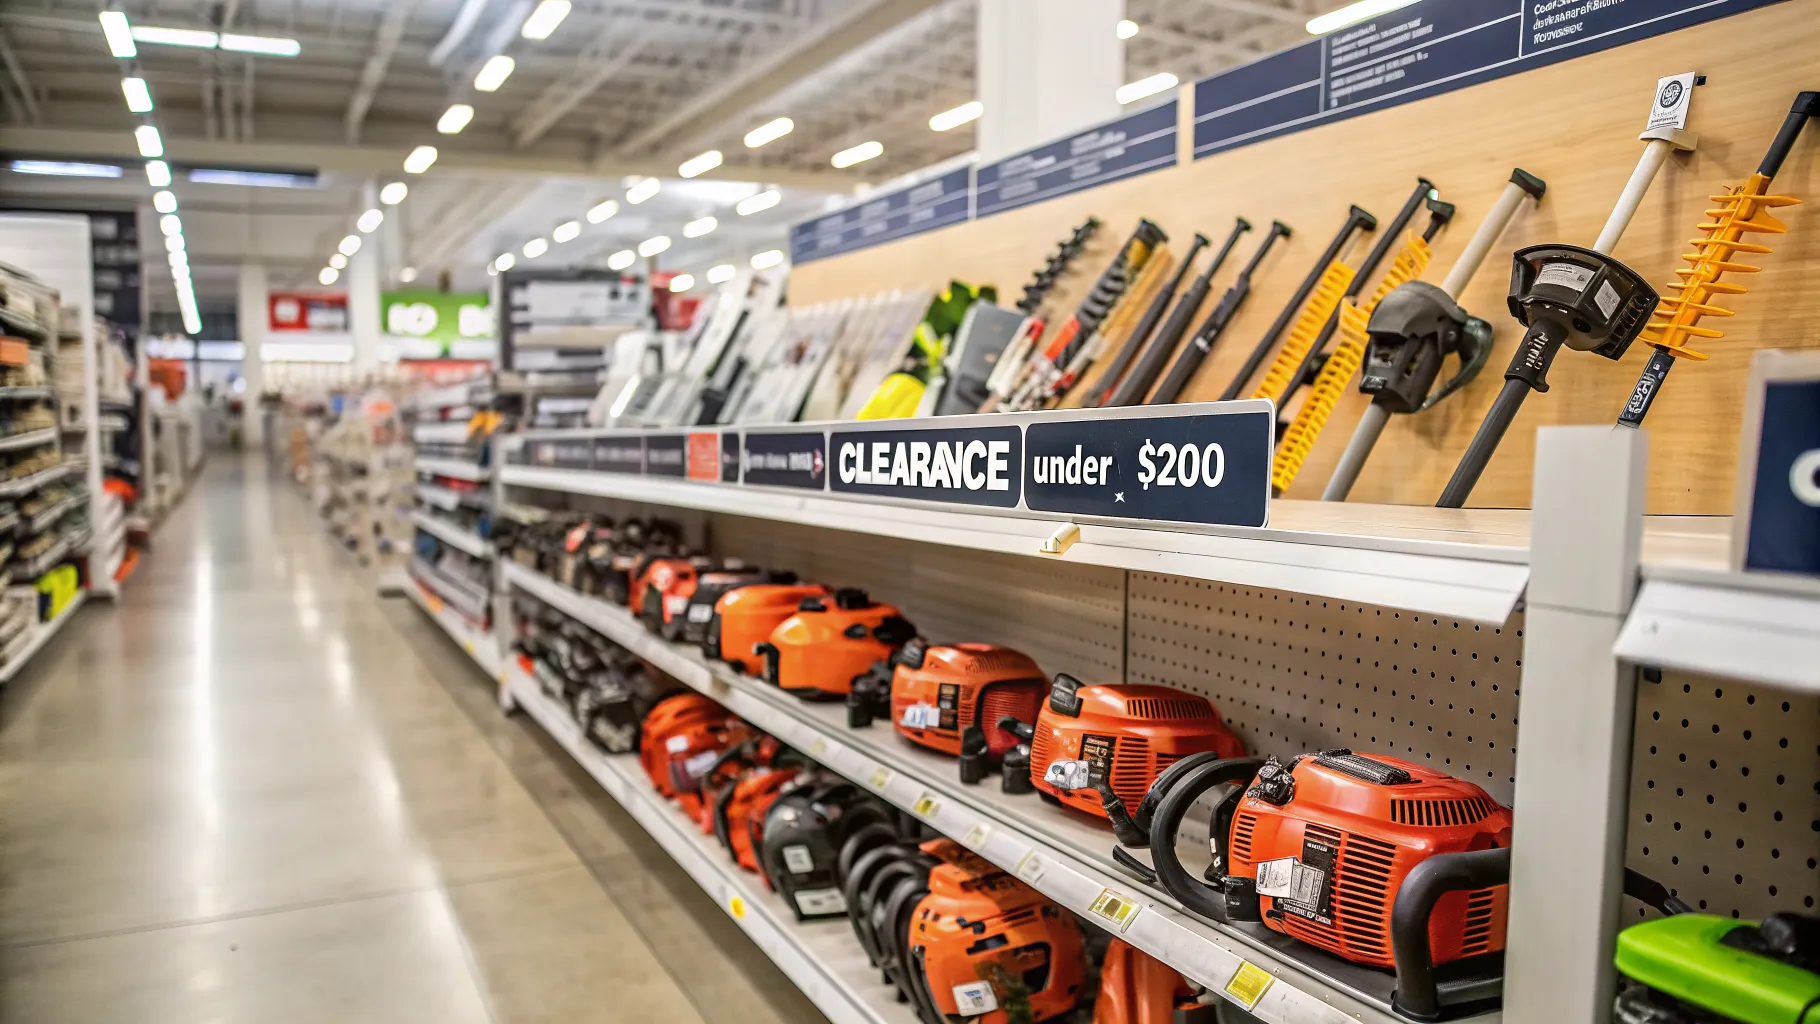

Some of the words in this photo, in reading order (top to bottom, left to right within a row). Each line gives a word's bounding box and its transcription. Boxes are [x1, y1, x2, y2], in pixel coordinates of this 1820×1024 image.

[839, 439, 1010, 491] CLEARANCE
[1033, 444, 1113, 486] under
[1137, 438, 1225, 491] $200
